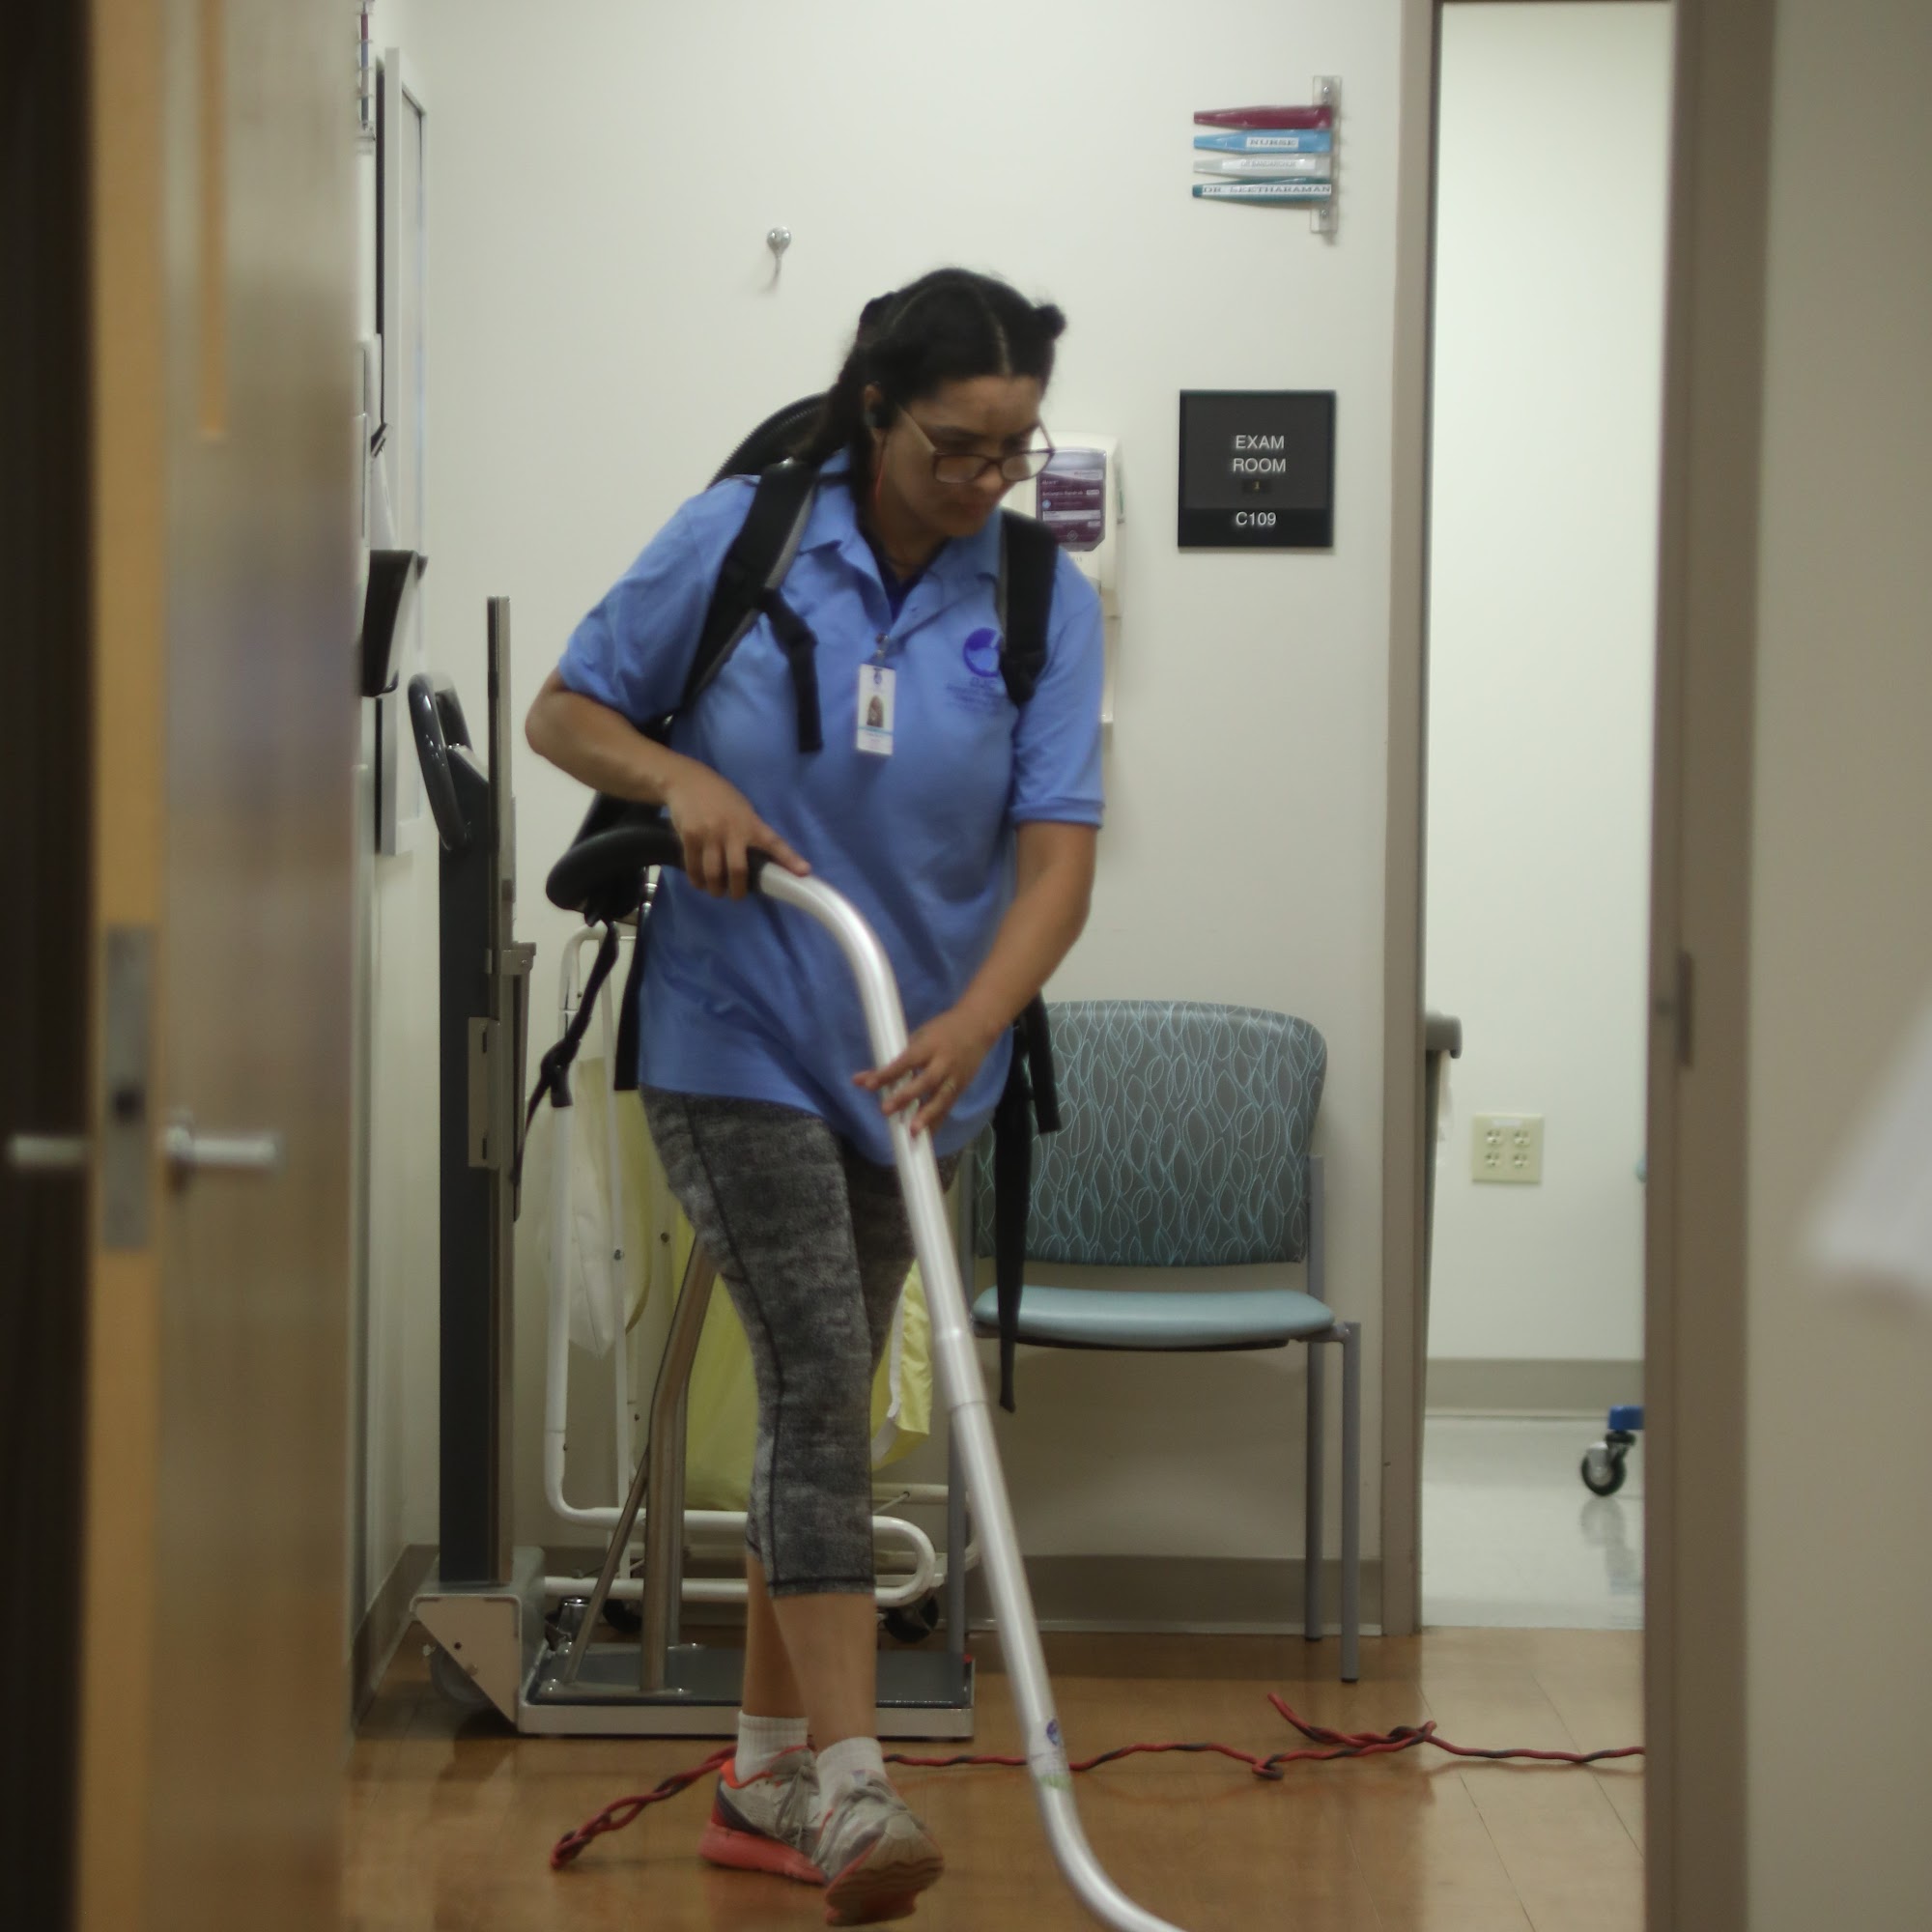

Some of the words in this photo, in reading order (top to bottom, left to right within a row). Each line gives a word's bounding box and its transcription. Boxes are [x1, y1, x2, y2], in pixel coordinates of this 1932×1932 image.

[1250, 138, 1296, 147] NURSE
[1235, 435, 1285, 449] EXAM
[1233, 457, 1287, 472] ROOM
[1236, 511, 1277, 526] C109
